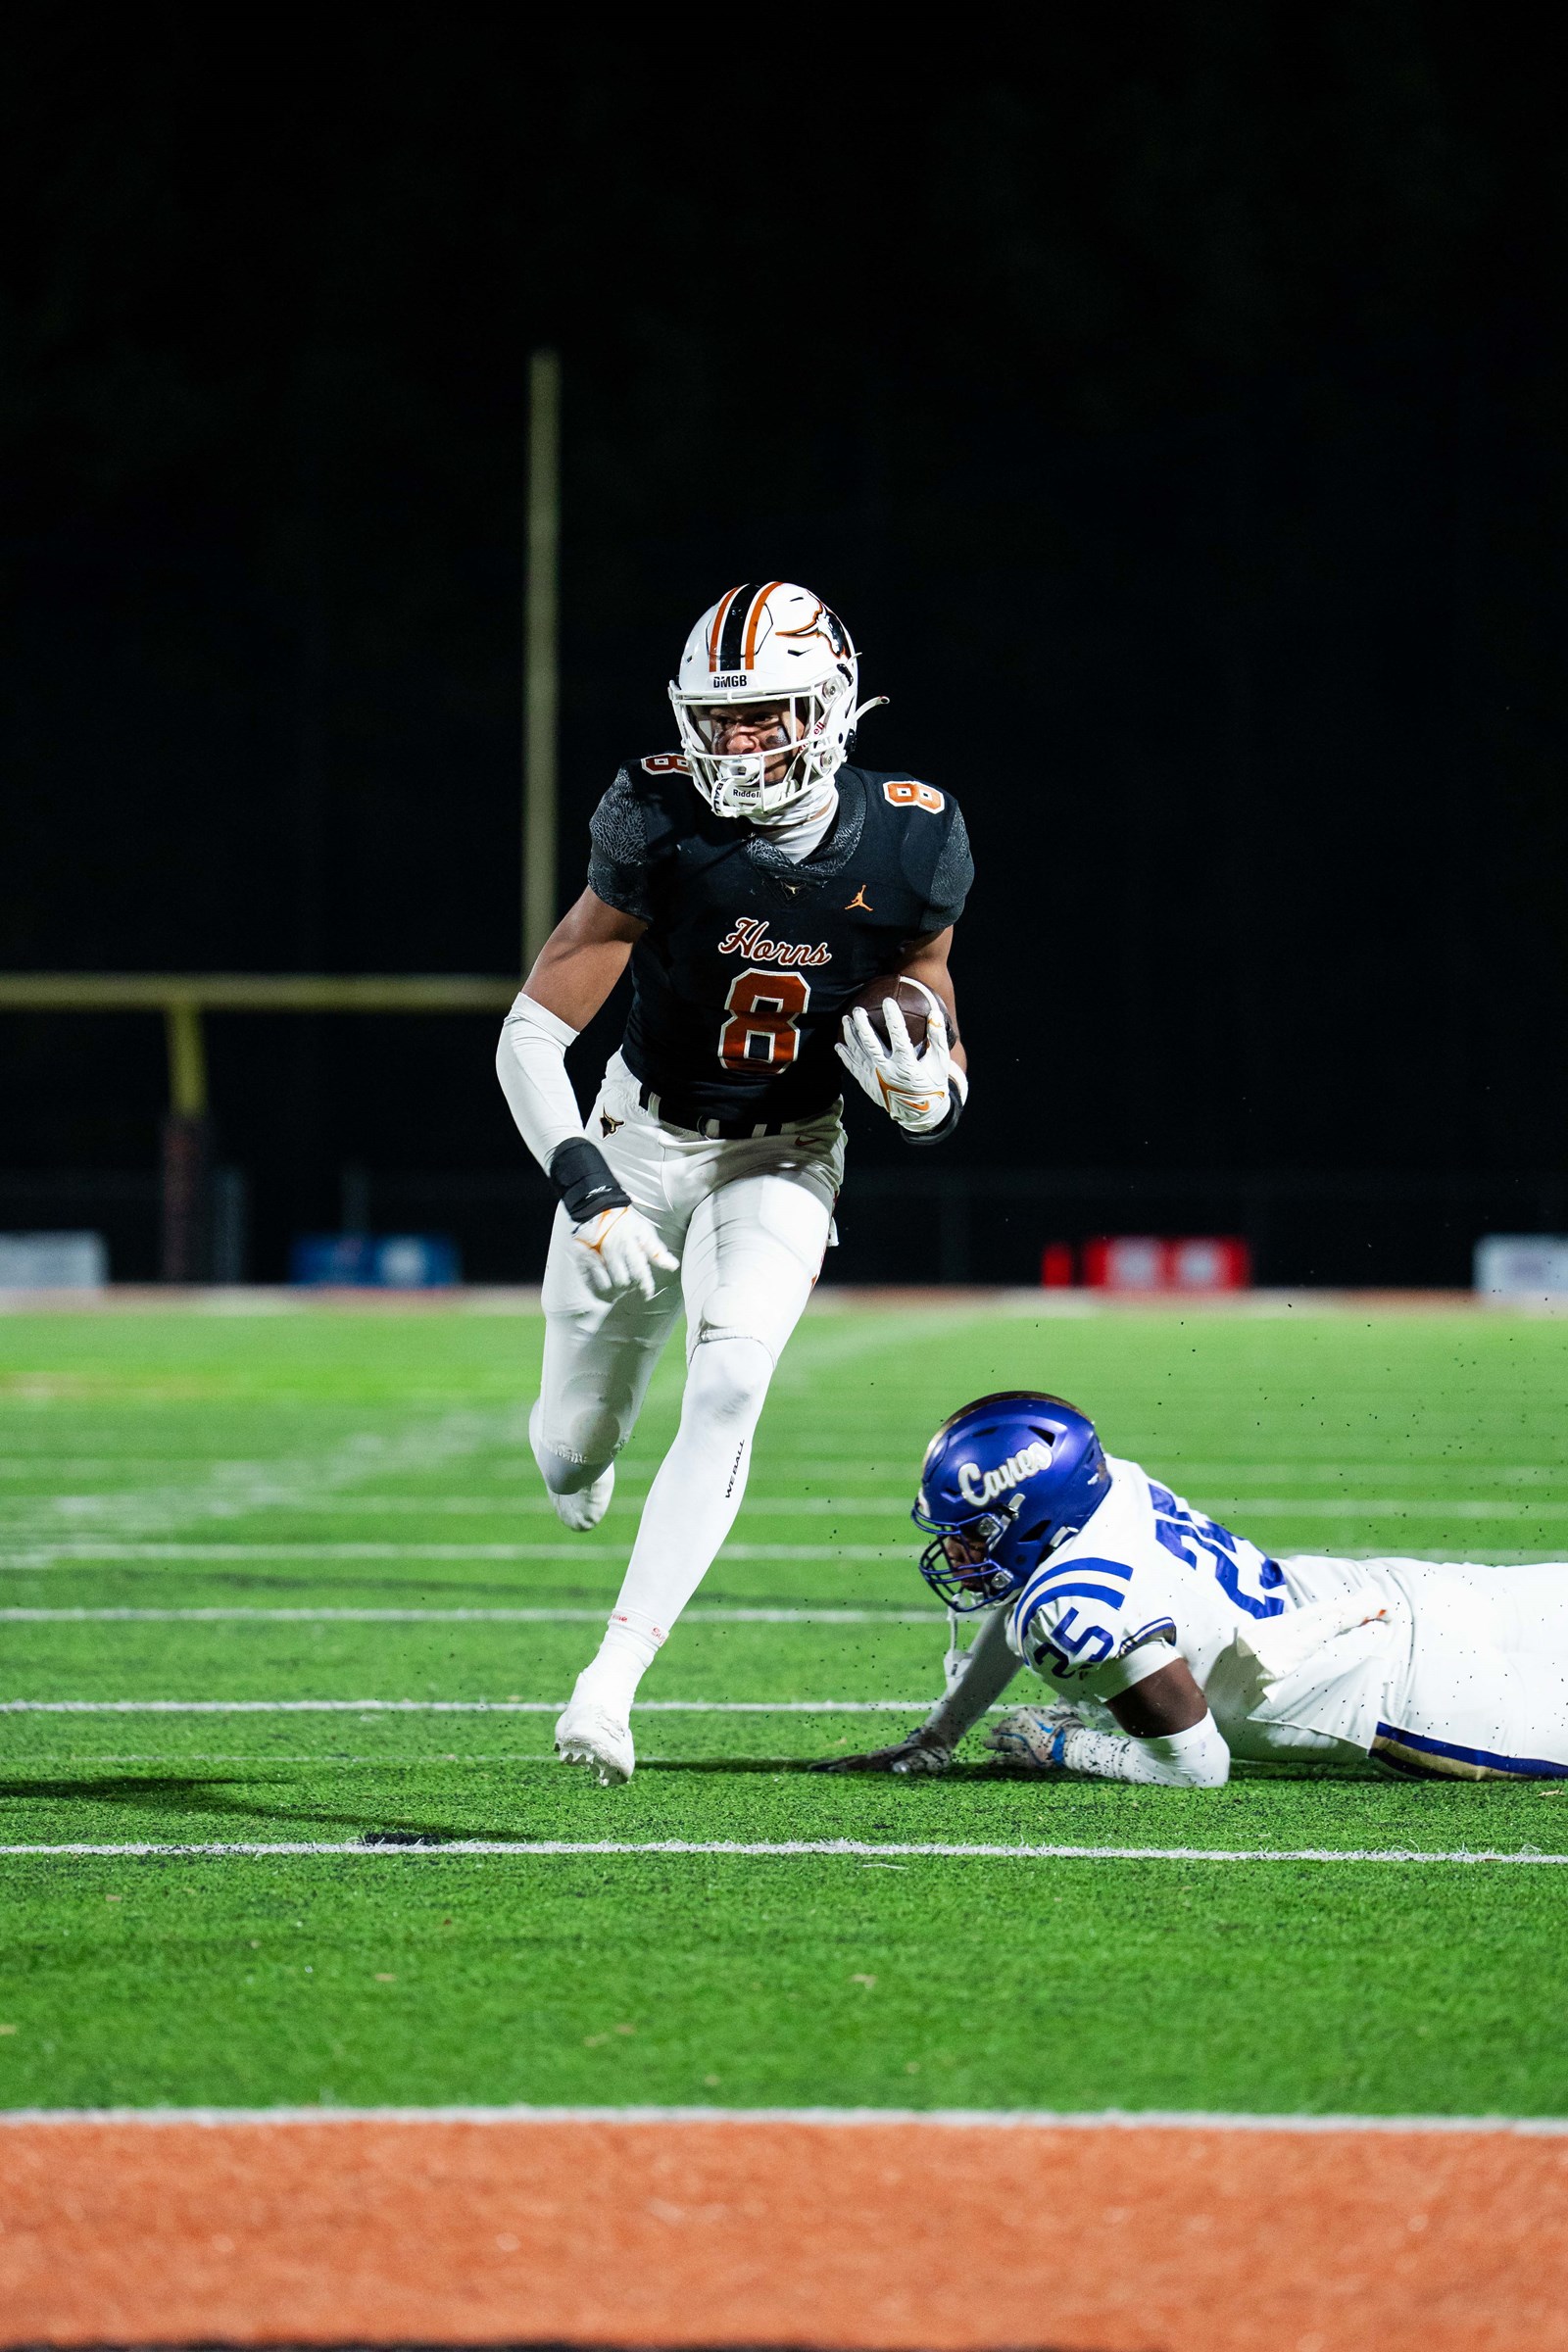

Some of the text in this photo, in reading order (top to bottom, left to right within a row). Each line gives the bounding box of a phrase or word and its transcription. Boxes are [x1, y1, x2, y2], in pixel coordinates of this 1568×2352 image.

[640, 753, 693, 777] 8
[882, 781, 945, 814] 8
[718, 917, 832, 966] Horns
[717, 967, 810, 1074] 8
[732, 1439, 745, 1476] BALL
[957, 1442, 1053, 1507] Canes
[1033, 1606, 1114, 1681] 25
